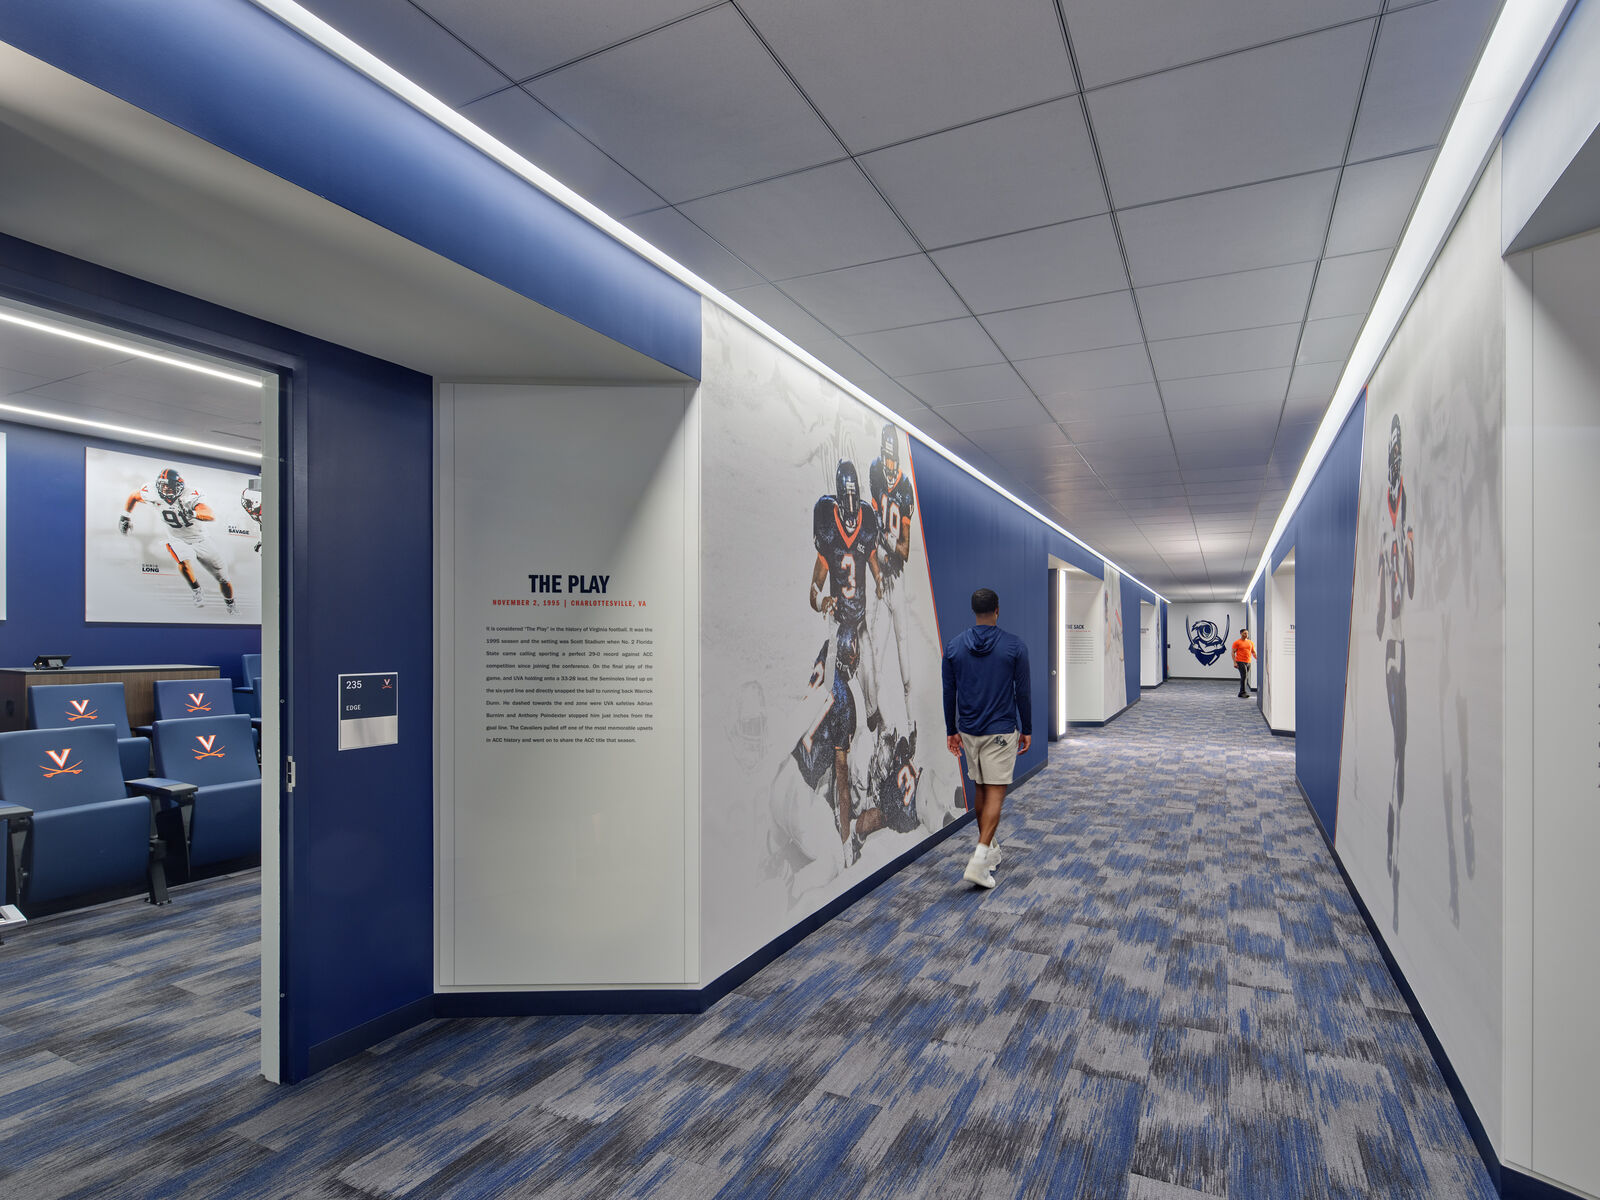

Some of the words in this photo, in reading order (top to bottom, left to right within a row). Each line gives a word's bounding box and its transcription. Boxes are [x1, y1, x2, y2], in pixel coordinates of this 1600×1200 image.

[162, 510, 193, 528] 91
[528, 574, 562, 593] THE
[568, 575, 610, 594] PLAY
[841, 553, 856, 599] 3
[346, 680, 362, 690] 235
